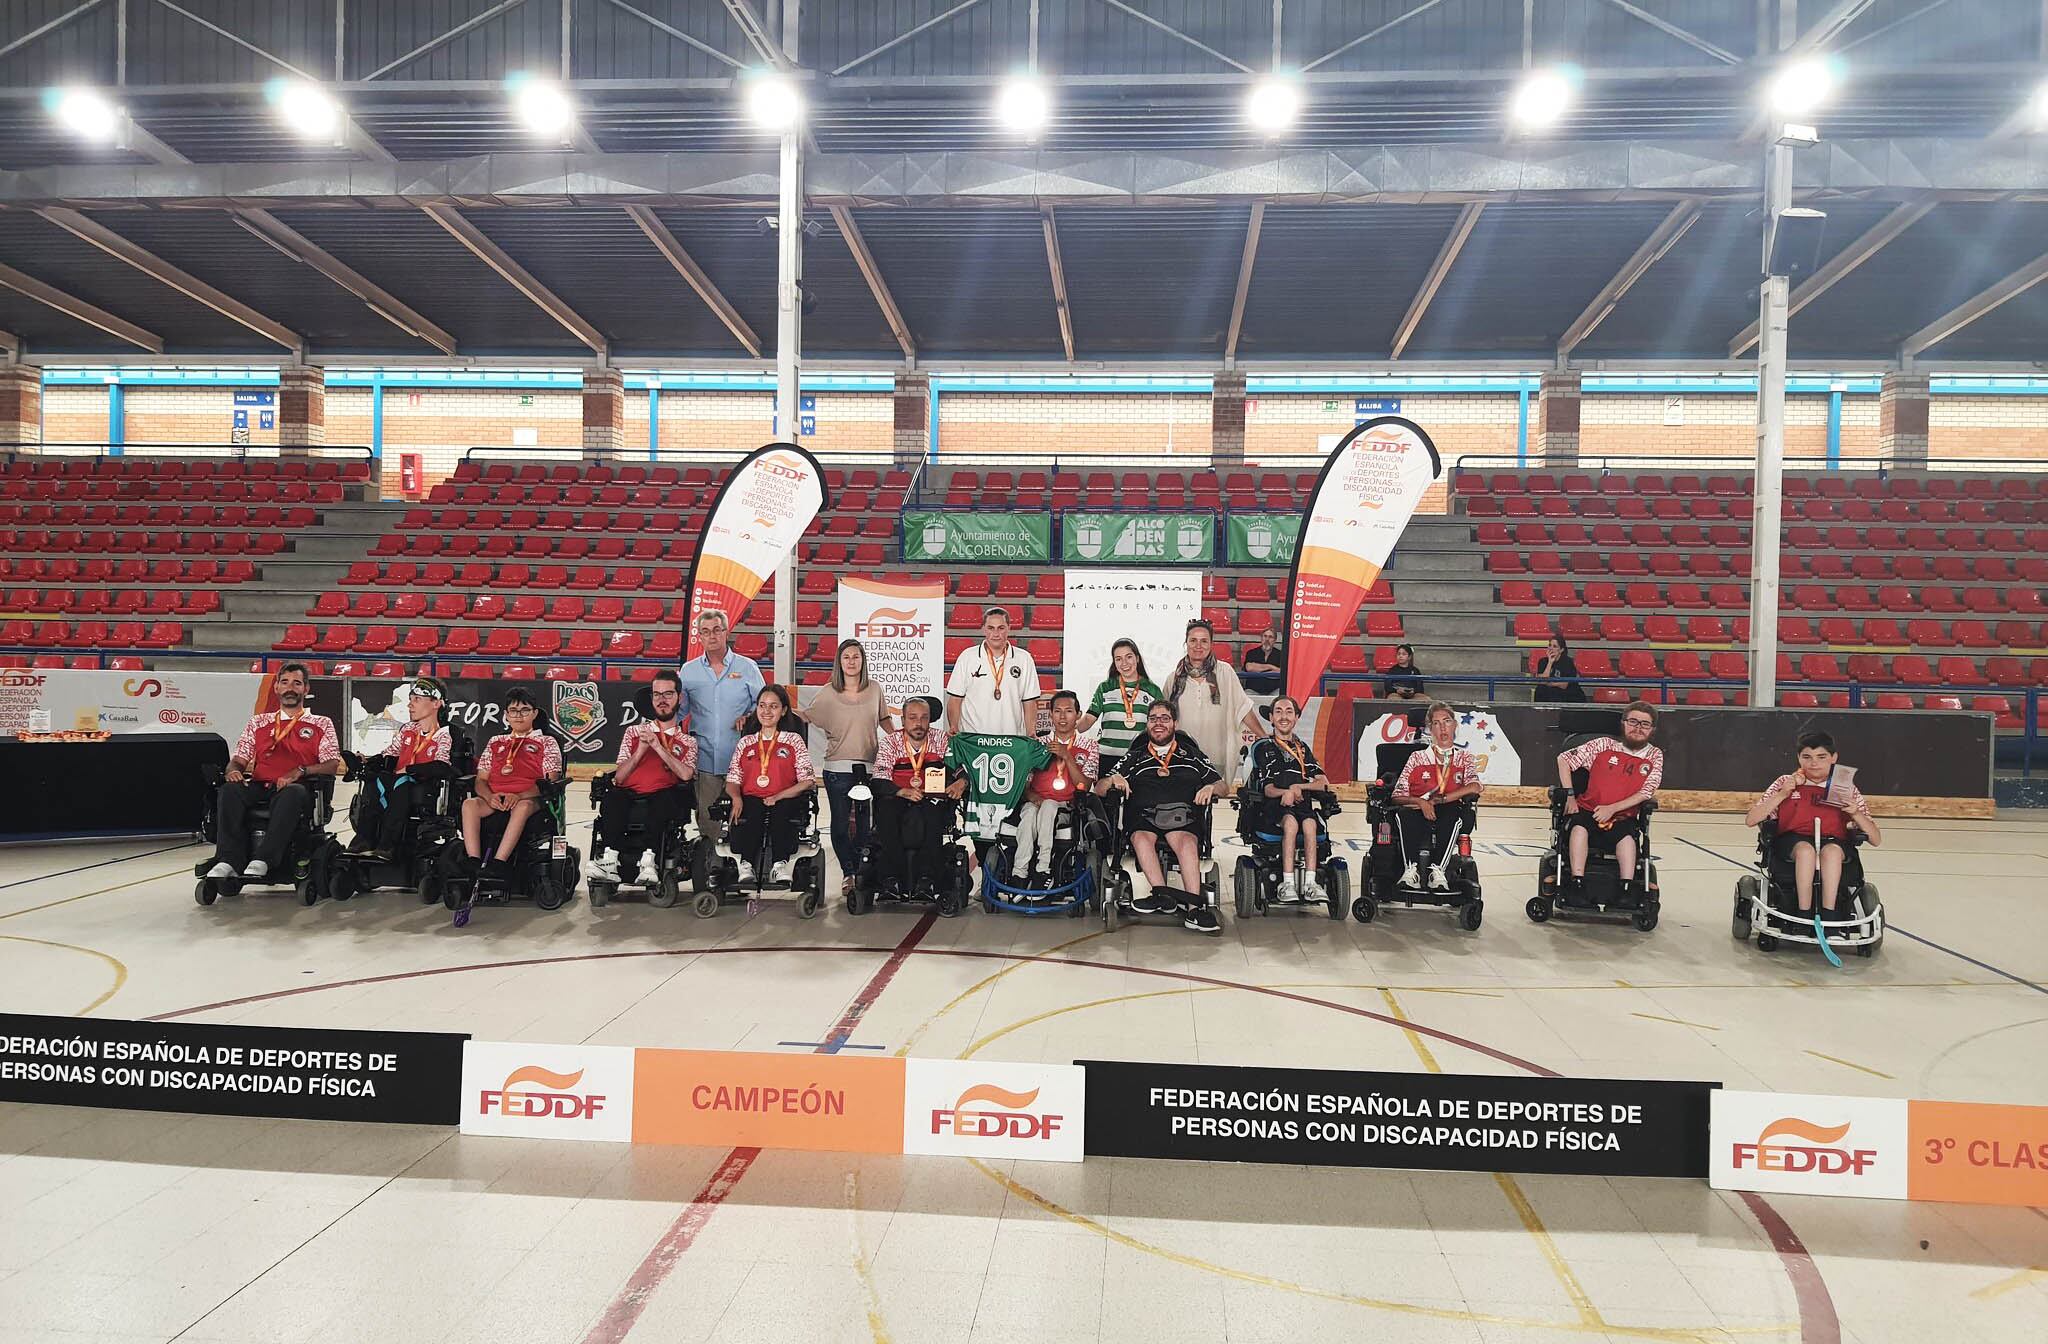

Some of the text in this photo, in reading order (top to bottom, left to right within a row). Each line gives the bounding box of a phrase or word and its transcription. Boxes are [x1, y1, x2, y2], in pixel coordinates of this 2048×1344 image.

[1351, 440, 1412, 454] FEDDF
[754, 459, 808, 481] FEDDF
[1357, 468, 1400, 479] DEPORTES
[1348, 476, 1393, 486] PERSONAS
[1343, 484, 1403, 496] DISCAPACIDAD
[1136, 519, 1166, 528] ALCO
[950, 529, 1031, 543] Ayuntamiento de
[1135, 530, 1166, 543] BEN
[950, 544, 1031, 556] ALCOBENDAS
[1135, 544, 1165, 556] DAS
[854, 623, 932, 638] FEDDF
[868, 662, 924, 673] DEPORTES
[871, 674, 916, 683] RSONAS
[0, 687, 42, 696] EDERACIÓN
[885, 685, 931, 694] PACIDAD
[884, 695, 908, 705] SICA
[977, 737, 1013, 747] ANDRÉS
[972, 752, 1015, 795] 19
[0, 1036, 397, 1071] DERACIÓN ESPAÑOLA DE DEPORTES DE
[0, 1062, 376, 1097] ERSONAS CON DISCAPACIDAD FÍSICA
[480, 1090, 606, 1120] FEDDF
[693, 1083, 844, 1116] CAMPEÓN
[1151, 1087, 1642, 1124] FEDERACIÓN ESPAÑOLA DE DEPORTES DE
[931, 1109, 1064, 1140] FEDDF
[1172, 1117, 1620, 1151] PERSONAS CON DISCAPACIDAD FÍSICA
[1732, 1143, 1878, 1177] FEDDF
